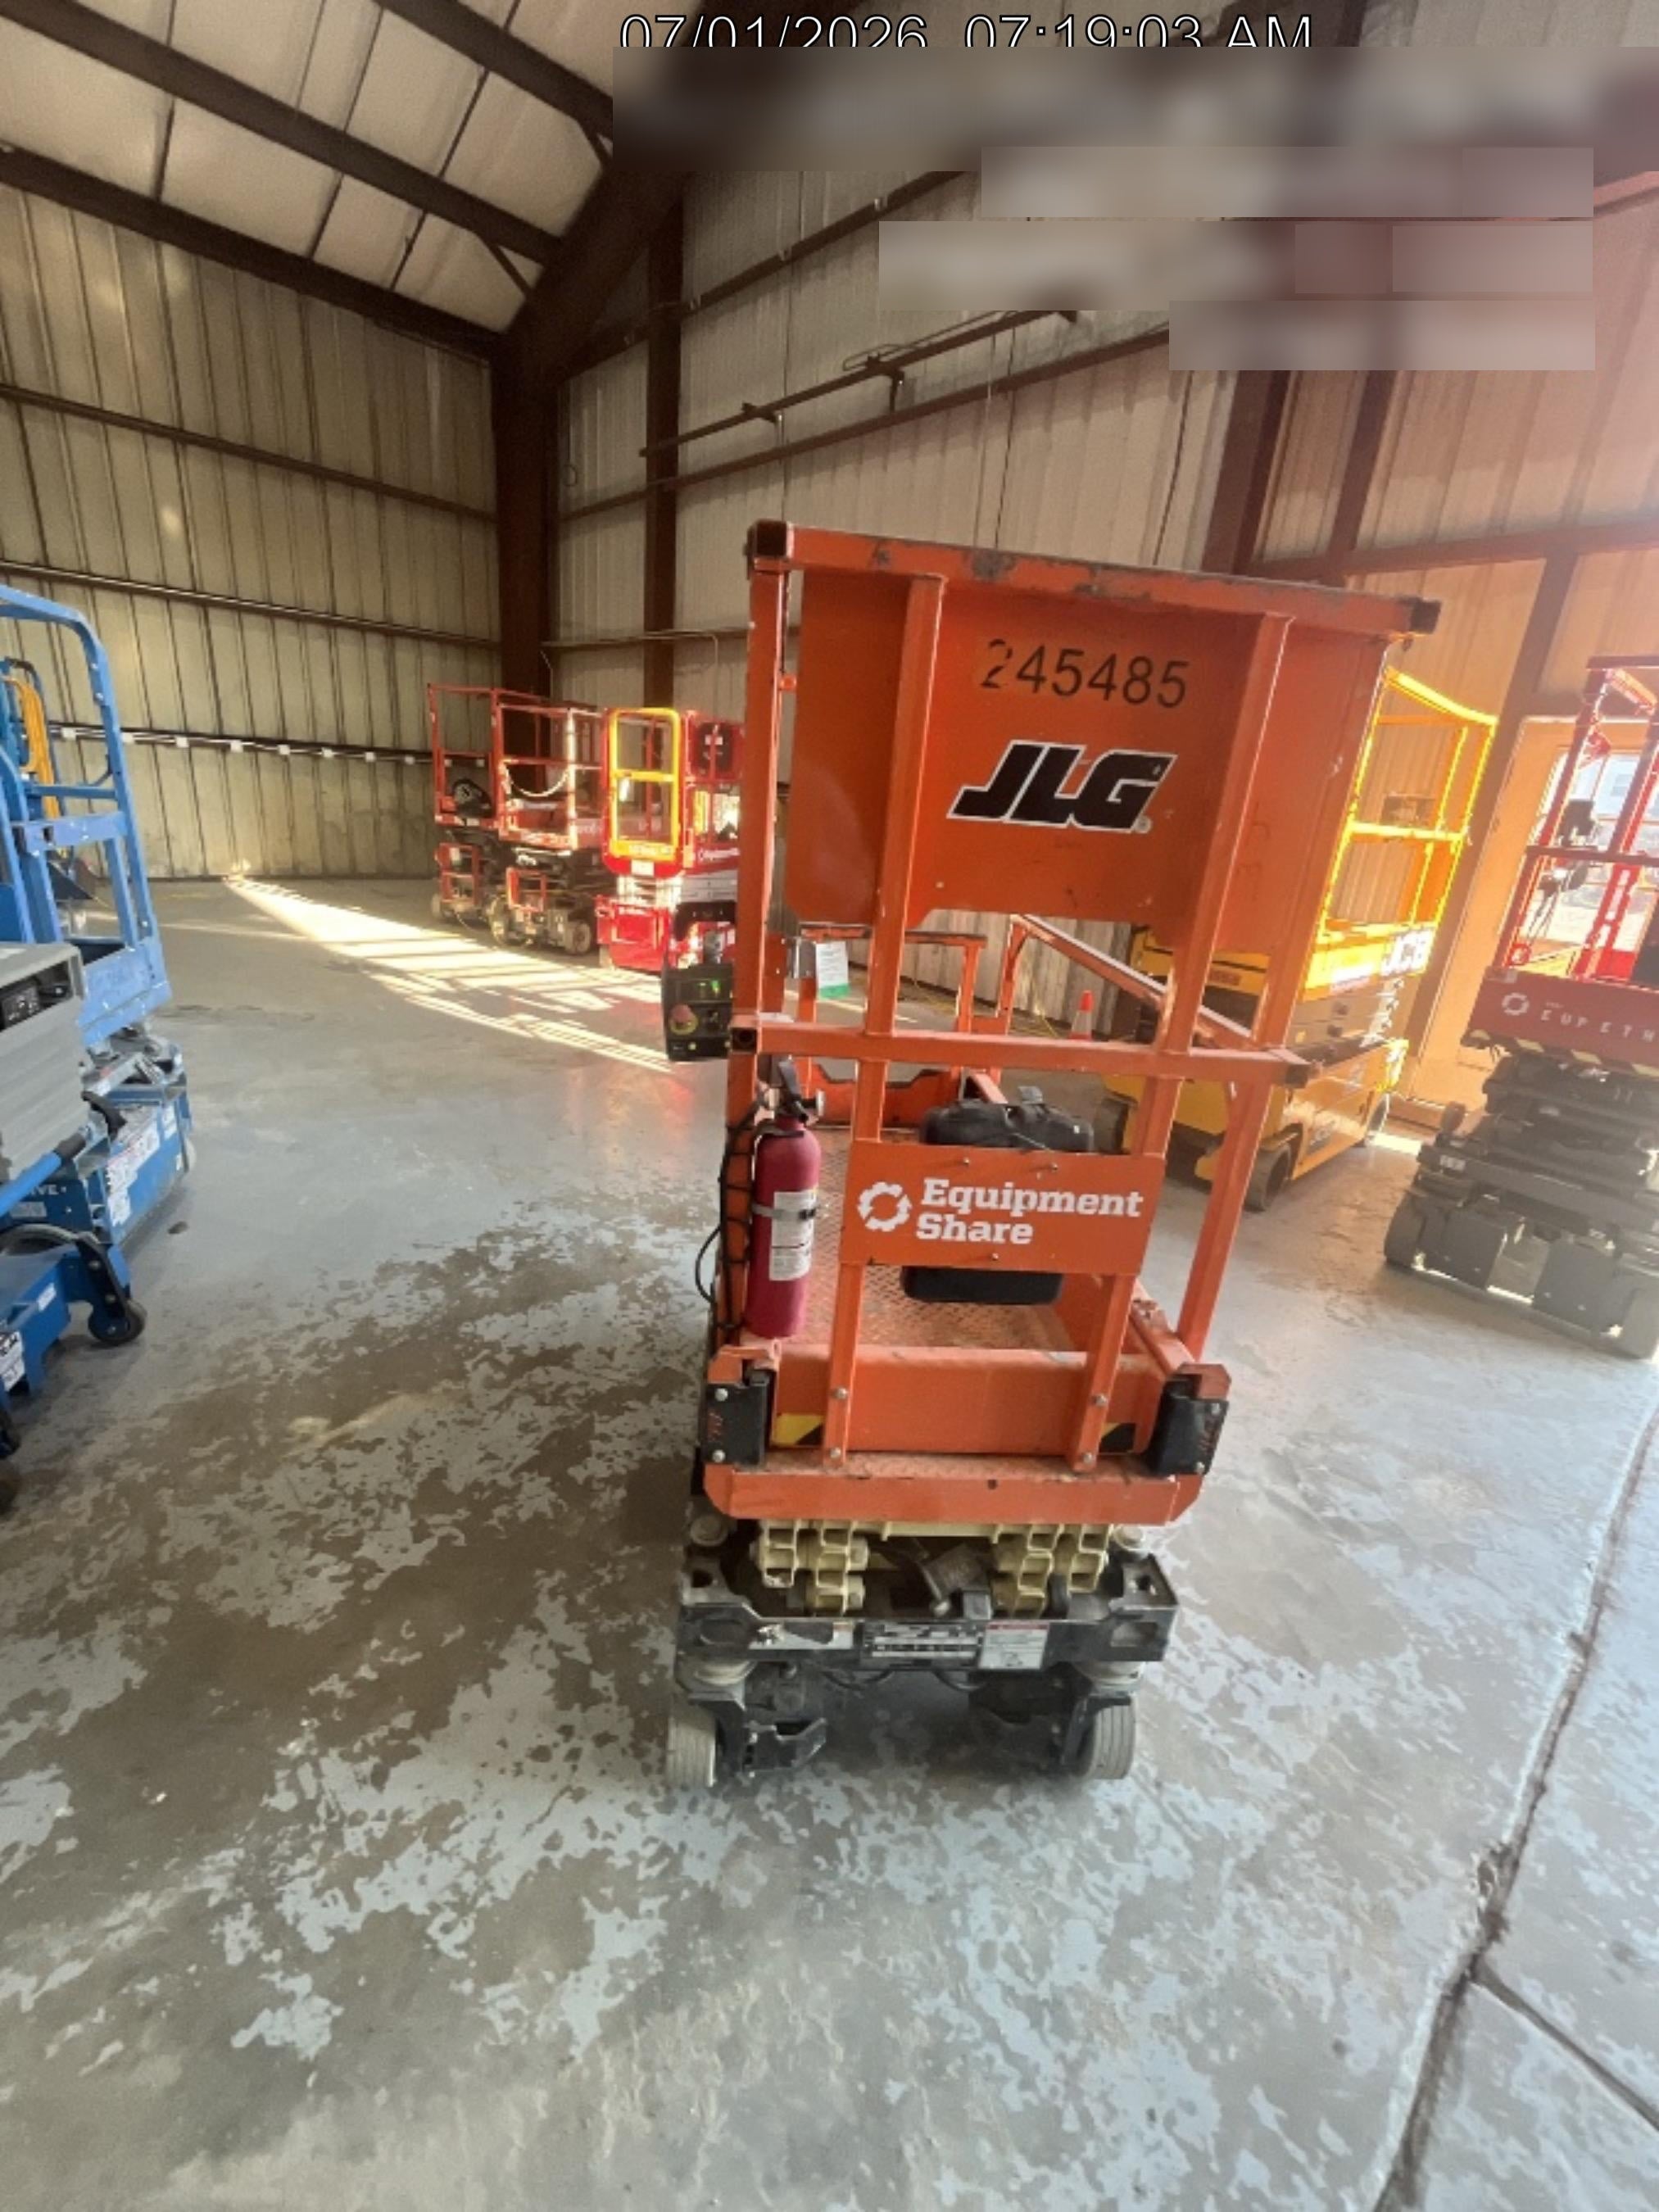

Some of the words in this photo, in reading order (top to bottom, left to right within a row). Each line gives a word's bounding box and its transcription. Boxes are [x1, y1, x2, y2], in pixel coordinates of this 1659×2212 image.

[981, 638, 1190, 708] 245485
[946, 739, 1178, 834] JLG
[921, 1177, 1145, 1217] Equipment
[915, 1212, 1035, 1244] Share
